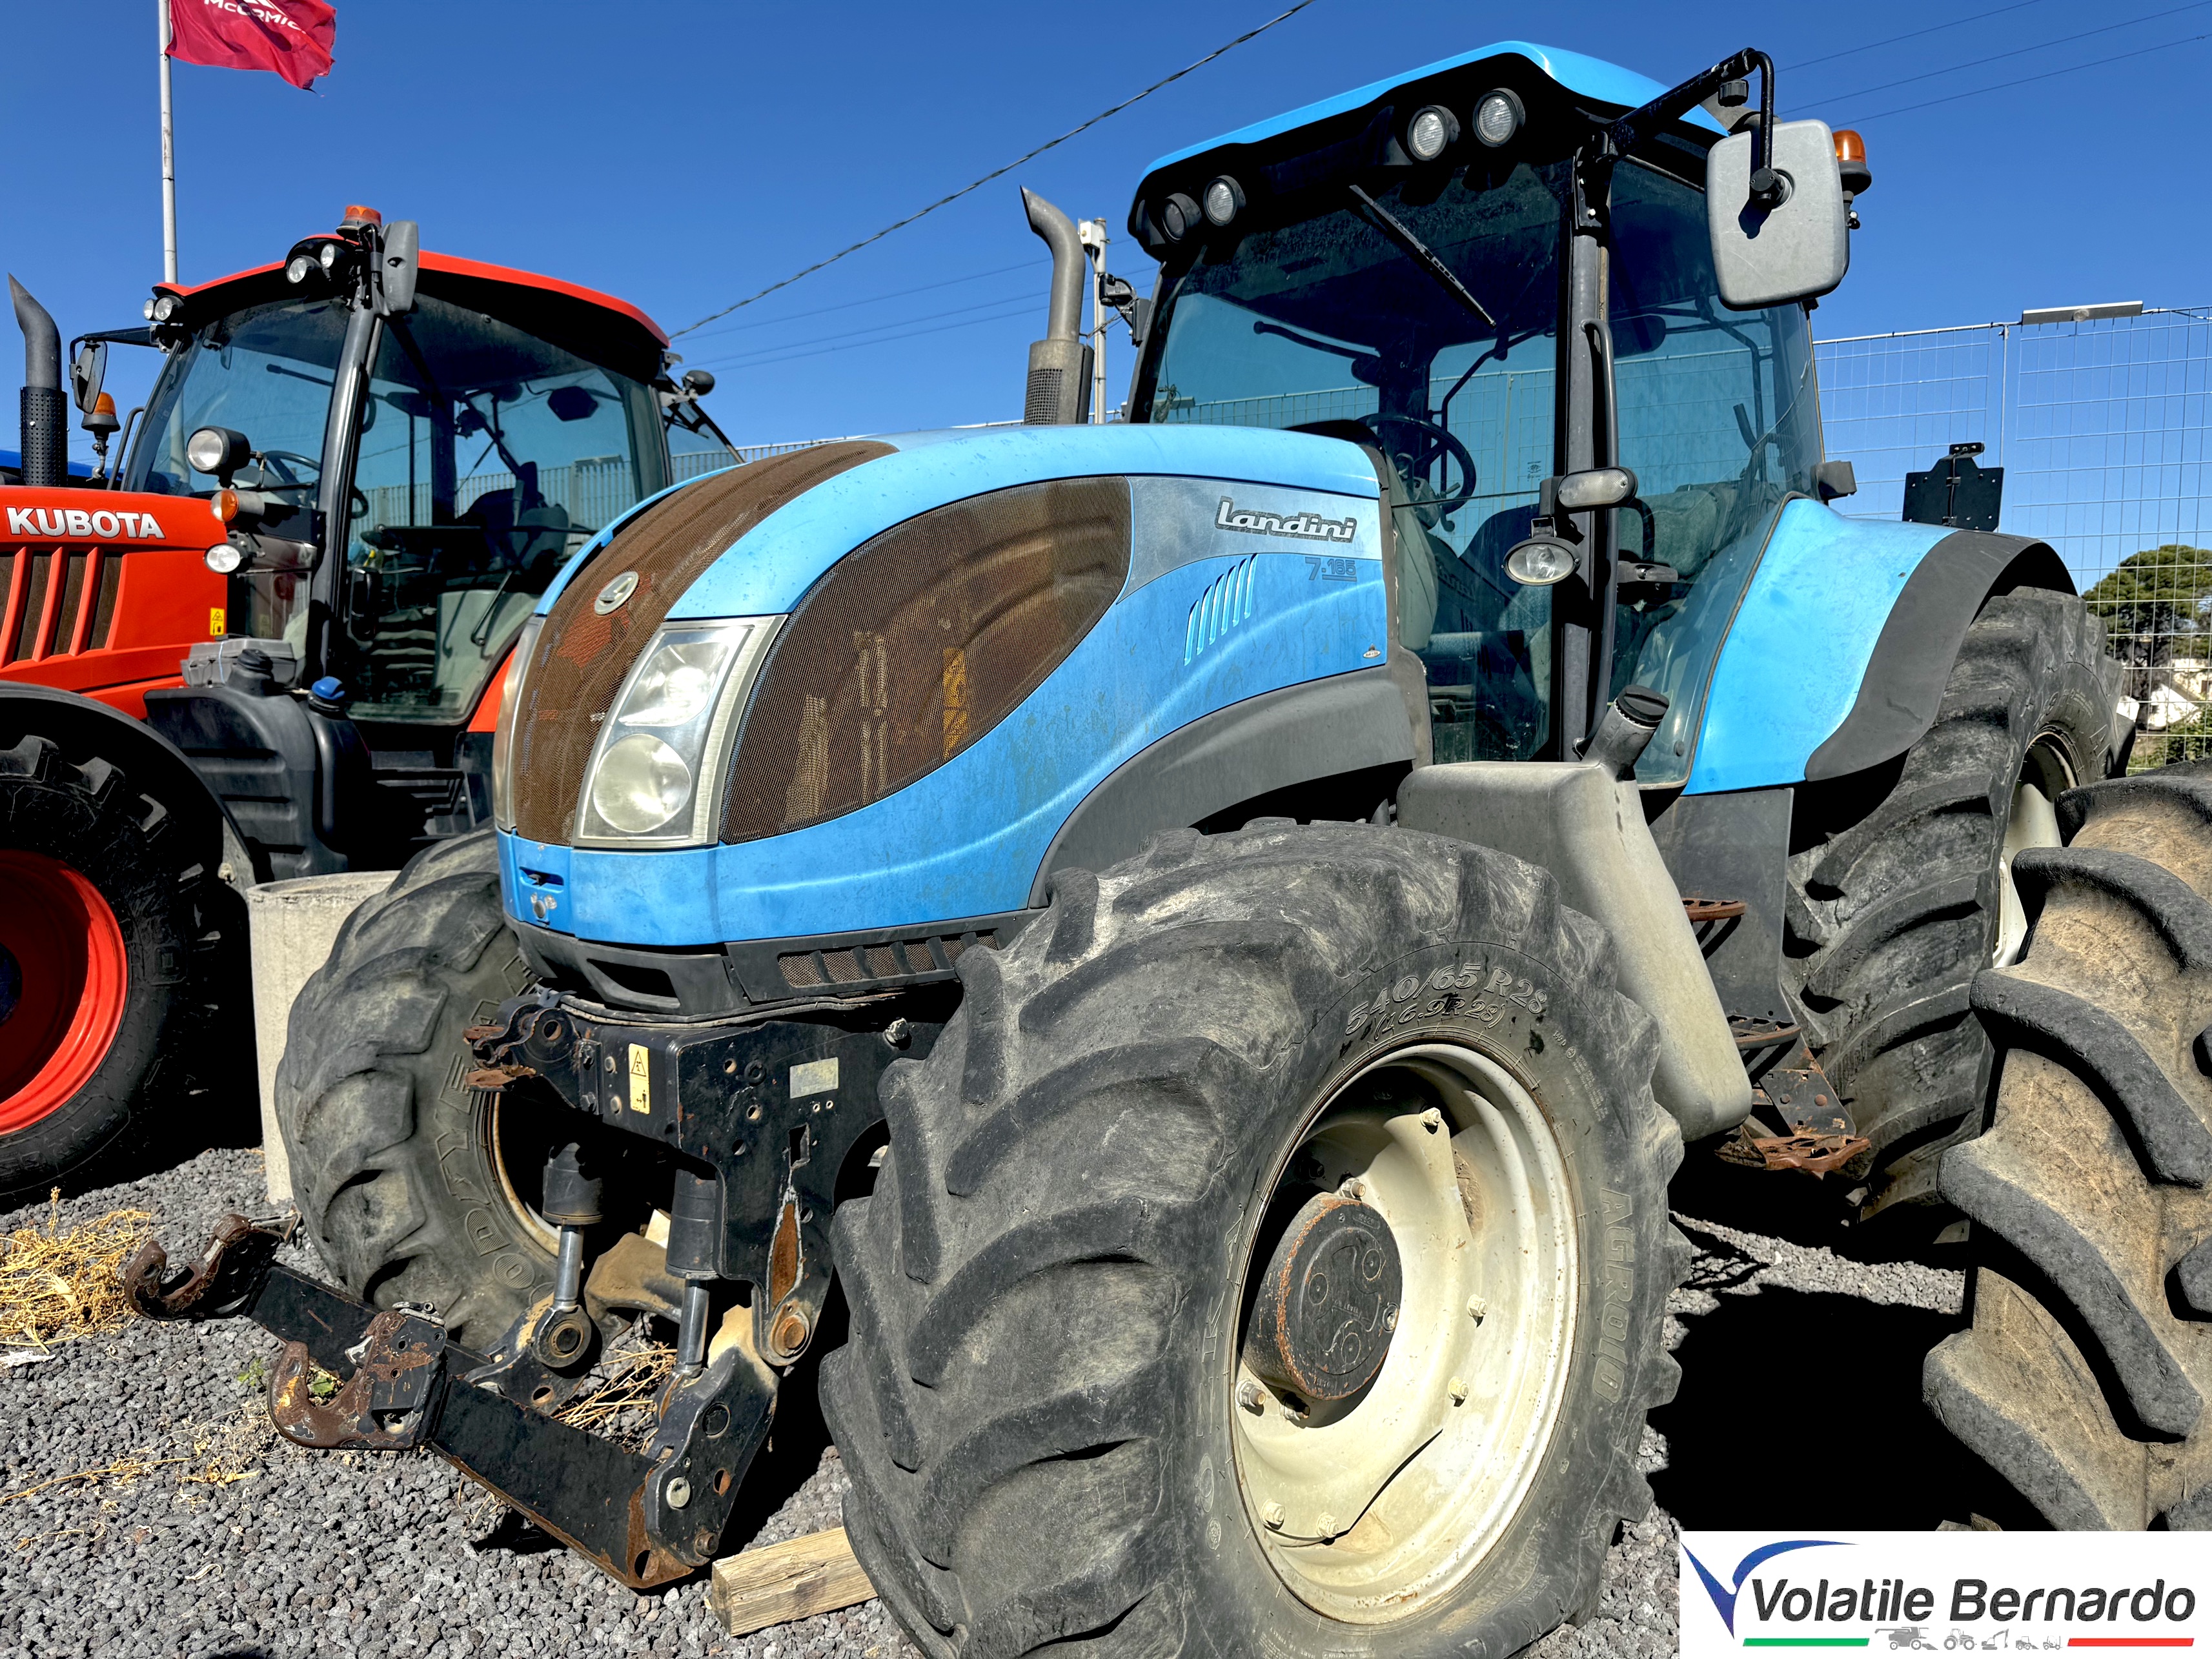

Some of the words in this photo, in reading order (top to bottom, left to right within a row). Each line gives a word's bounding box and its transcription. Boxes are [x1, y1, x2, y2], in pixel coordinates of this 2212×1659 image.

[6, 506, 166, 539] KUBOTA
[1216, 499, 1355, 541] Landini
[1344, 963, 1482, 1035] 540/65
